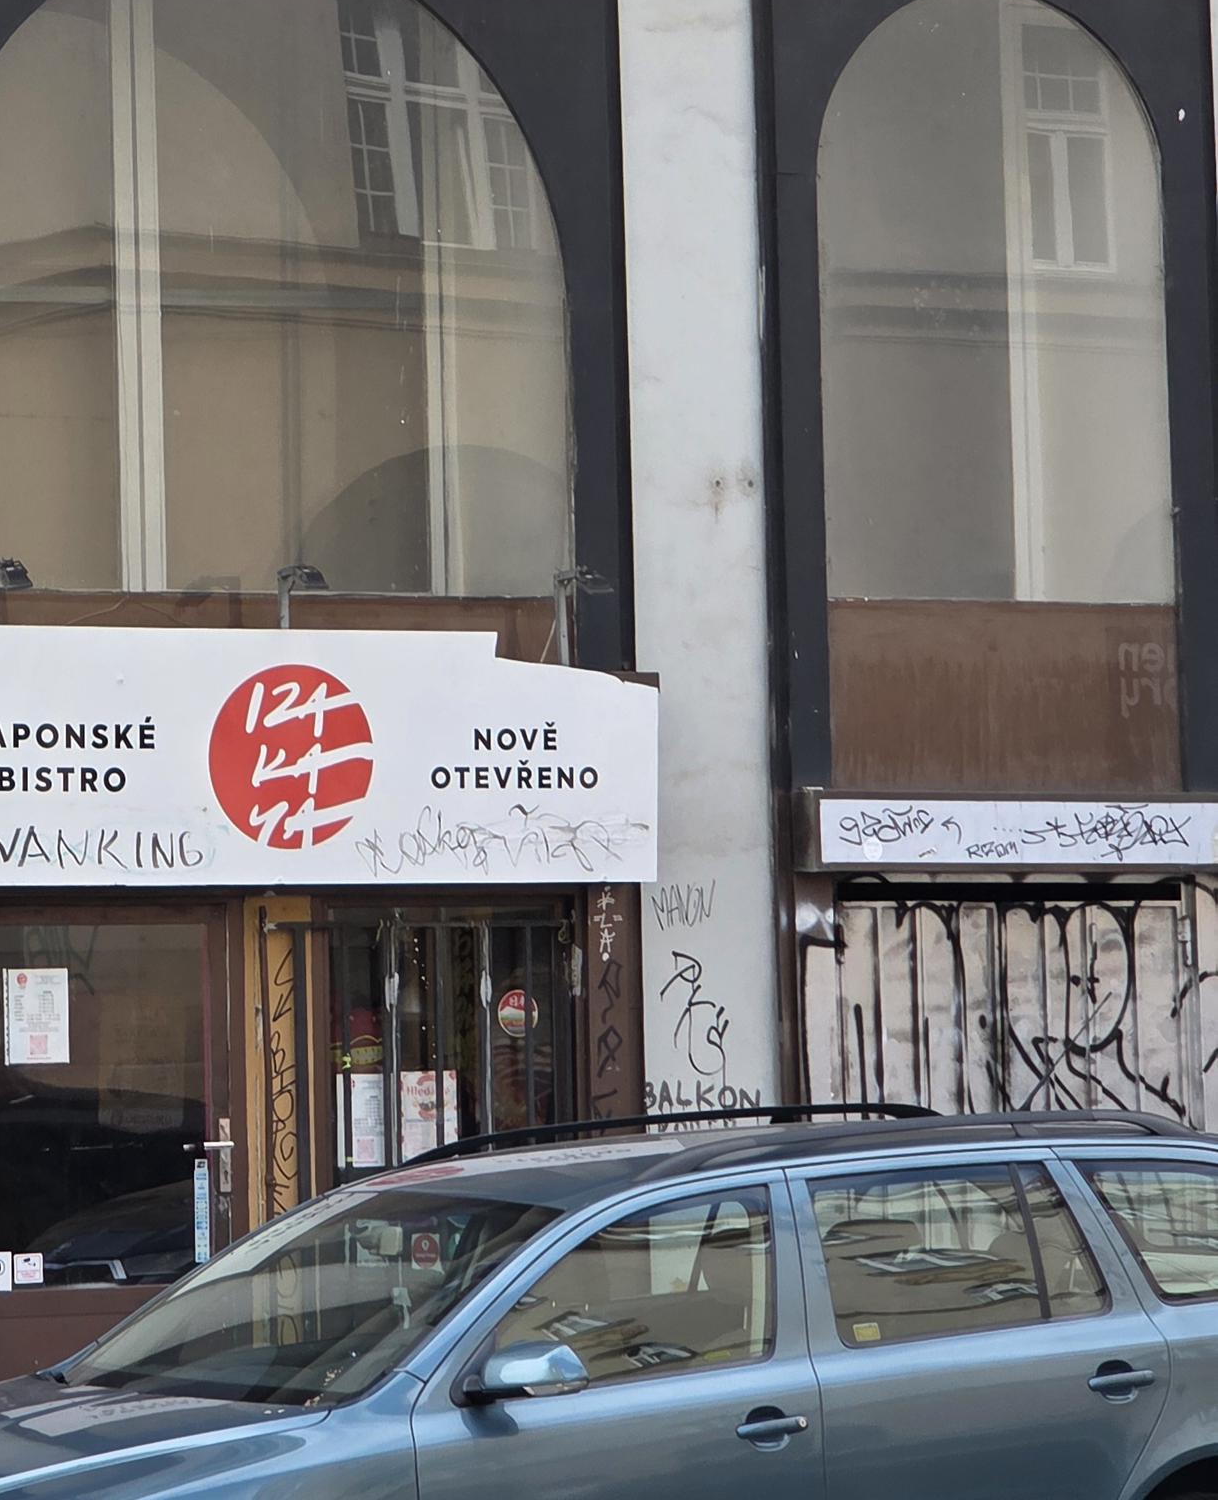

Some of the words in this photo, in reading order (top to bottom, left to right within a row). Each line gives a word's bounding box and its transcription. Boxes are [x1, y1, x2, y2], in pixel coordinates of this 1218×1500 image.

[473, 721, 558, 751] NOVĚ
[431, 760, 599, 790] OTEVŘENO
[644, 1079, 761, 1113] BALKON
